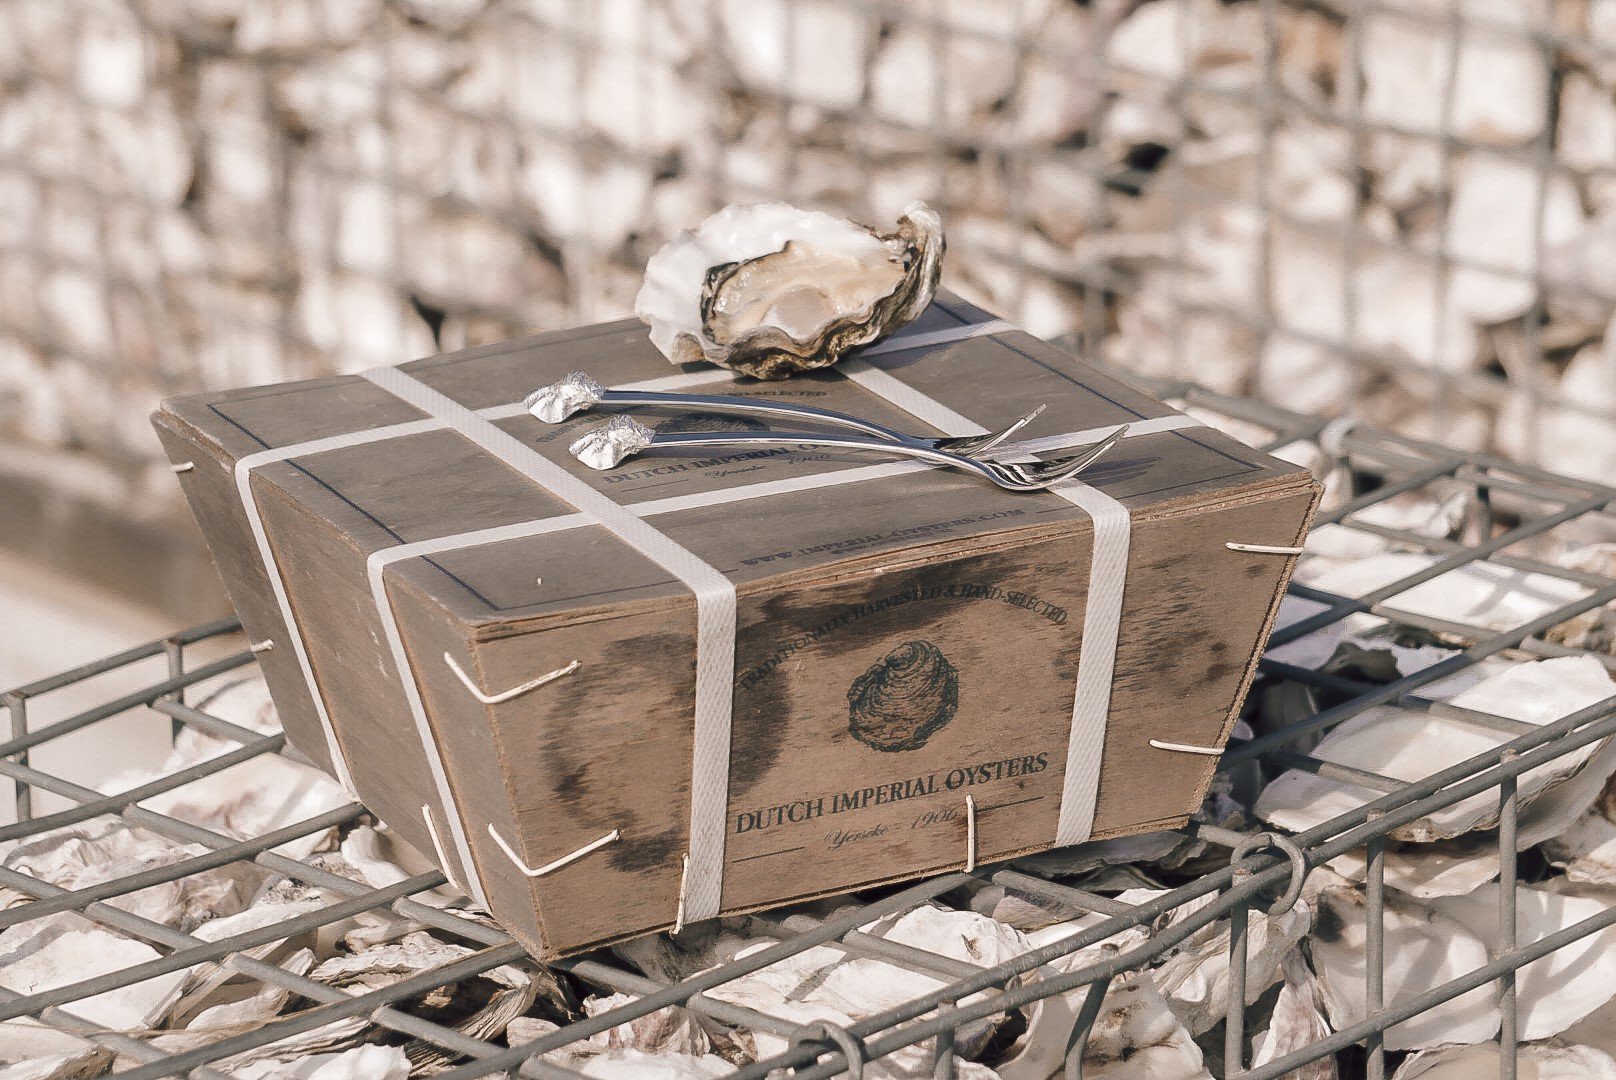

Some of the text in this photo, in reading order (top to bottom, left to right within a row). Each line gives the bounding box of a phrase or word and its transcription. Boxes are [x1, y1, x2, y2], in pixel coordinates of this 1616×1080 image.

[601, 463, 688, 484] DUTCH
[691, 447, 790, 469] IMPERIAL
[960, 583, 1068, 624] HAND-SELECTED
[734, 751, 1049, 834] DUTCH IMPERIAL OYSTERS
[824, 807, 957, 851] Yerseke 1906
